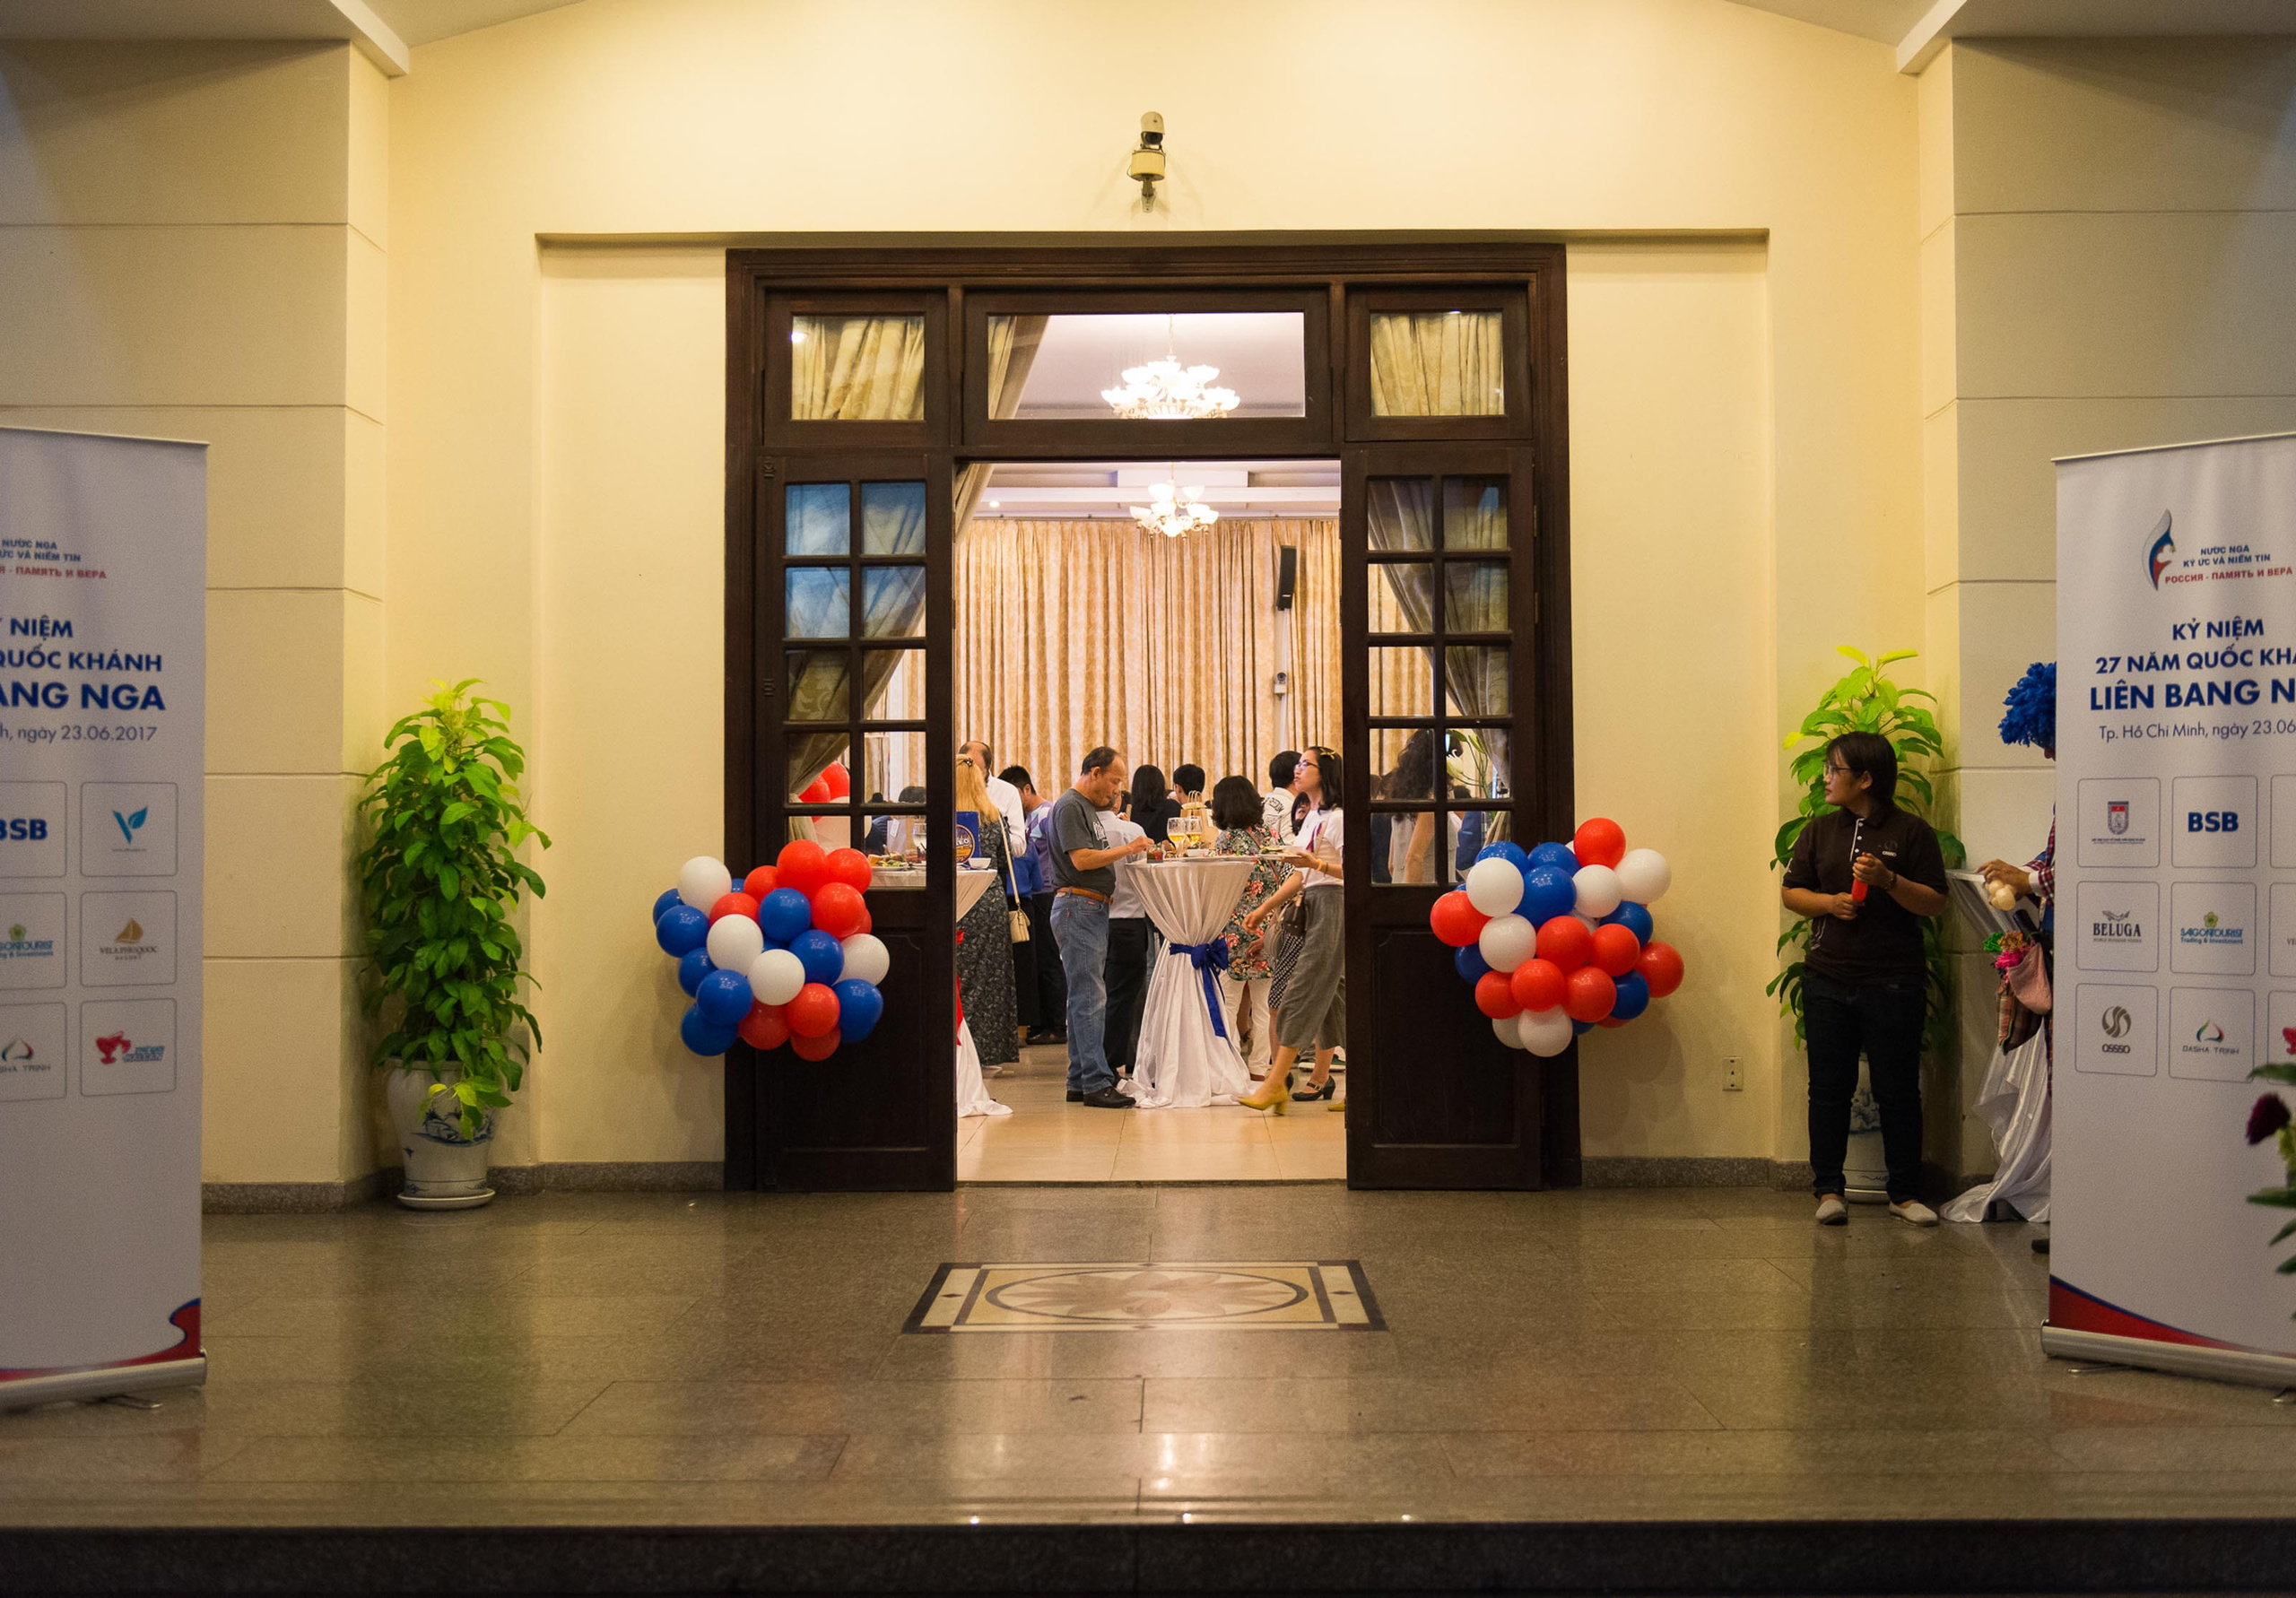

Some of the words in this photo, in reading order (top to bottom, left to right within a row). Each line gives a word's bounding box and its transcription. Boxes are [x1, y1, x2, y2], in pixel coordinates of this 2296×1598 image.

[64, 552, 82, 562] TIN
[2229, 544, 2249, 553] NGA
[2255, 553, 2271, 562] TIN
[15, 566, 62, 578] ПАМЯТЬ
[65, 569, 74, 578] И
[77, 569, 107, 579] ВЕРА
[2165, 573, 2204, 584] РОССИЯ
[2212, 569, 2254, 580] ПАМЯТЬ
[2257, 569, 2265, 578] И
[2267, 567, 2293, 577] ВЕРА
[10, 614, 74, 641] NIỆM
[2172, 617, 2202, 640] KỶ
[2206, 615, 2265, 642] NIỆM
[68, 648, 161, 673] KHÁNH
[2096, 656, 2121, 674] 27
[2127, 651, 2180, 673] NĂM
[2186, 643, 2253, 671] QUỐC
[81, 682, 166, 711] NGA
[2090, 679, 2153, 710] LIÊN
[2165, 679, 2260, 708] BANG
[17, 726, 57, 744] ngày
[60, 725, 158, 743] 23.06.2017
[2100, 725, 2119, 743] Tp.
[2172, 720, 2208, 739] Minh,
[2213, 721, 2248, 740] ngày
[2187, 811, 2239, 833] BSB
[2092, 922, 2142, 938] BELUGA
